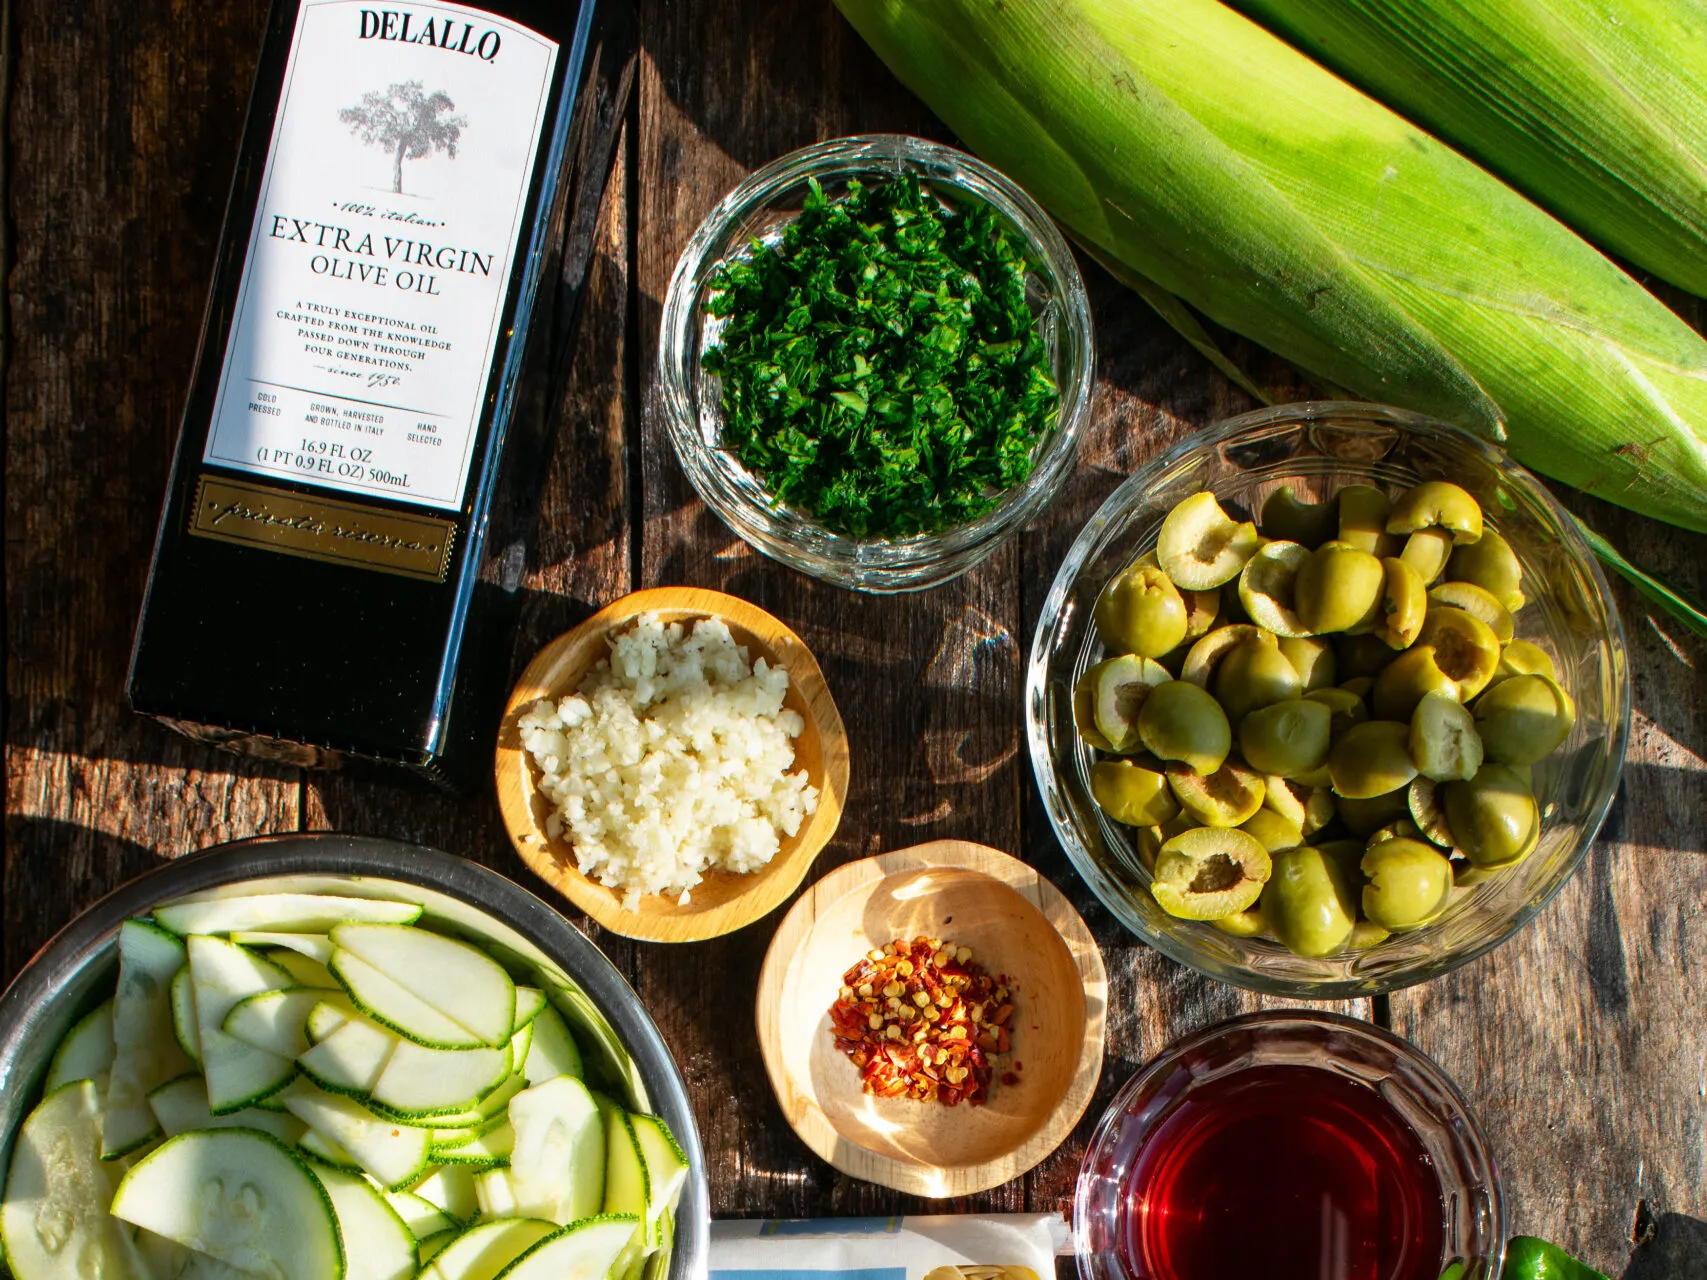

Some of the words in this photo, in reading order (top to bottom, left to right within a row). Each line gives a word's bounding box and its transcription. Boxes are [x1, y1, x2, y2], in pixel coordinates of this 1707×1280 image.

[358, 9, 501, 64] DELALLO
[380, 208, 439, 228] italian
[269, 215, 375, 256] EXTRA
[384, 235, 495, 277] VIRGIN
[311, 255, 389, 286] OLIVE
[396, 271, 440, 296] OIL
[276, 310, 325, 327] CRAFTED
[328, 321, 358, 334] FROM
[362, 327, 384, 338] THE
[387, 332, 452, 351] KNOWLEDGE
[296, 300, 303, 309] A
[306, 302, 341, 316] TRULY
[344, 310, 417, 331] EXCEPTIONAL
[420, 324, 439, 334] OIL
[297, 328, 335, 343] PASSED
[337, 337, 370, 349] DOWN
[373, 343, 426, 360] THROUGH
[304, 344, 333, 357] FOUR
[336, 350, 413, 372] GENERATIONS.
[248, 402, 281, 416] PRESSED
[257, 392, 277, 403] COLD
[304, 414, 319, 425] AND
[320, 415, 351, 430] BOTTLED
[354, 422, 363, 432] IN
[365, 424, 385, 436] ITALY
[343, 408, 385, 424] HARVESTED
[417, 422, 438, 433] HAND
[301, 438, 327, 455] 16.9
[329, 443, 347, 459] FL
[350, 447, 374, 464] OZ
[406, 432, 442, 446] SELECTED
[257, 446, 269, 463] (1
[273, 449, 293, 465] PT
[295, 455, 315, 470] 0.9
[318, 458, 335, 474] FL
[338, 463, 365, 481] OZ)
[369, 467, 411, 488] 500mL
